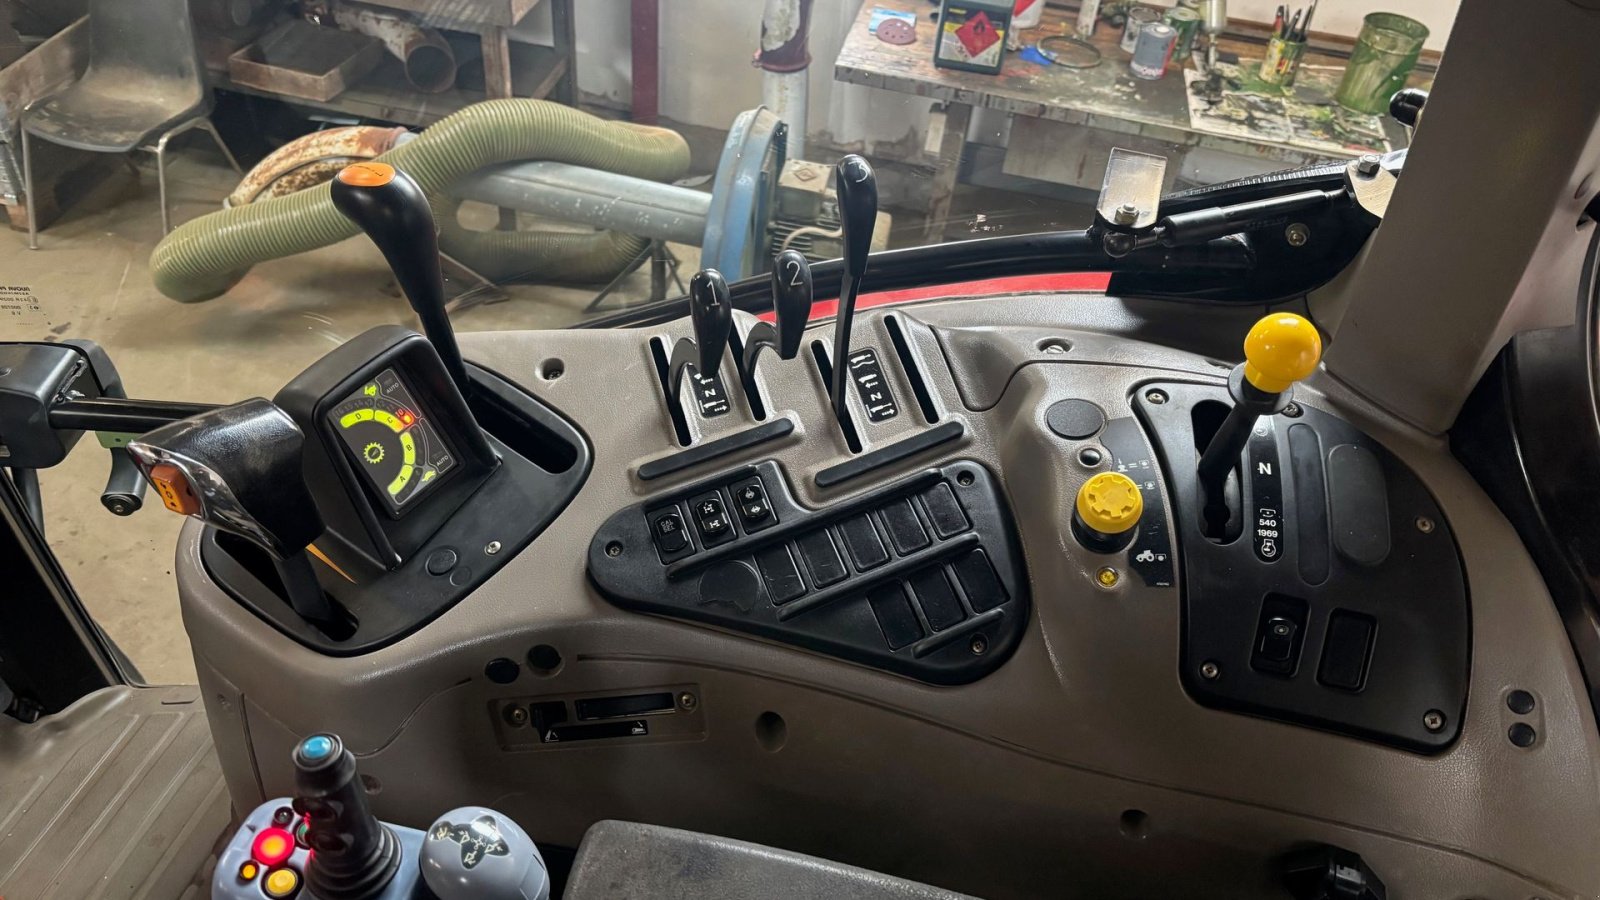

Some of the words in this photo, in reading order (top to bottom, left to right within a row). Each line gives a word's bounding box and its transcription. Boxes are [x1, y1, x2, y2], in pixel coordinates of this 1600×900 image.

[786, 260, 804, 286] 2
[706, 281, 720, 307] 1
[386, 383, 399, 393] AUTO
[704, 389, 716, 398] N
[870, 392, 883, 402] N
[395, 408, 405, 418] 10
[387, 416, 393, 424] C
[436, 456, 449, 466] AUTO
[1259, 462, 1272, 475] N
[1259, 519, 1277, 527] 540
[1257, 528, 1279, 538] 1969
